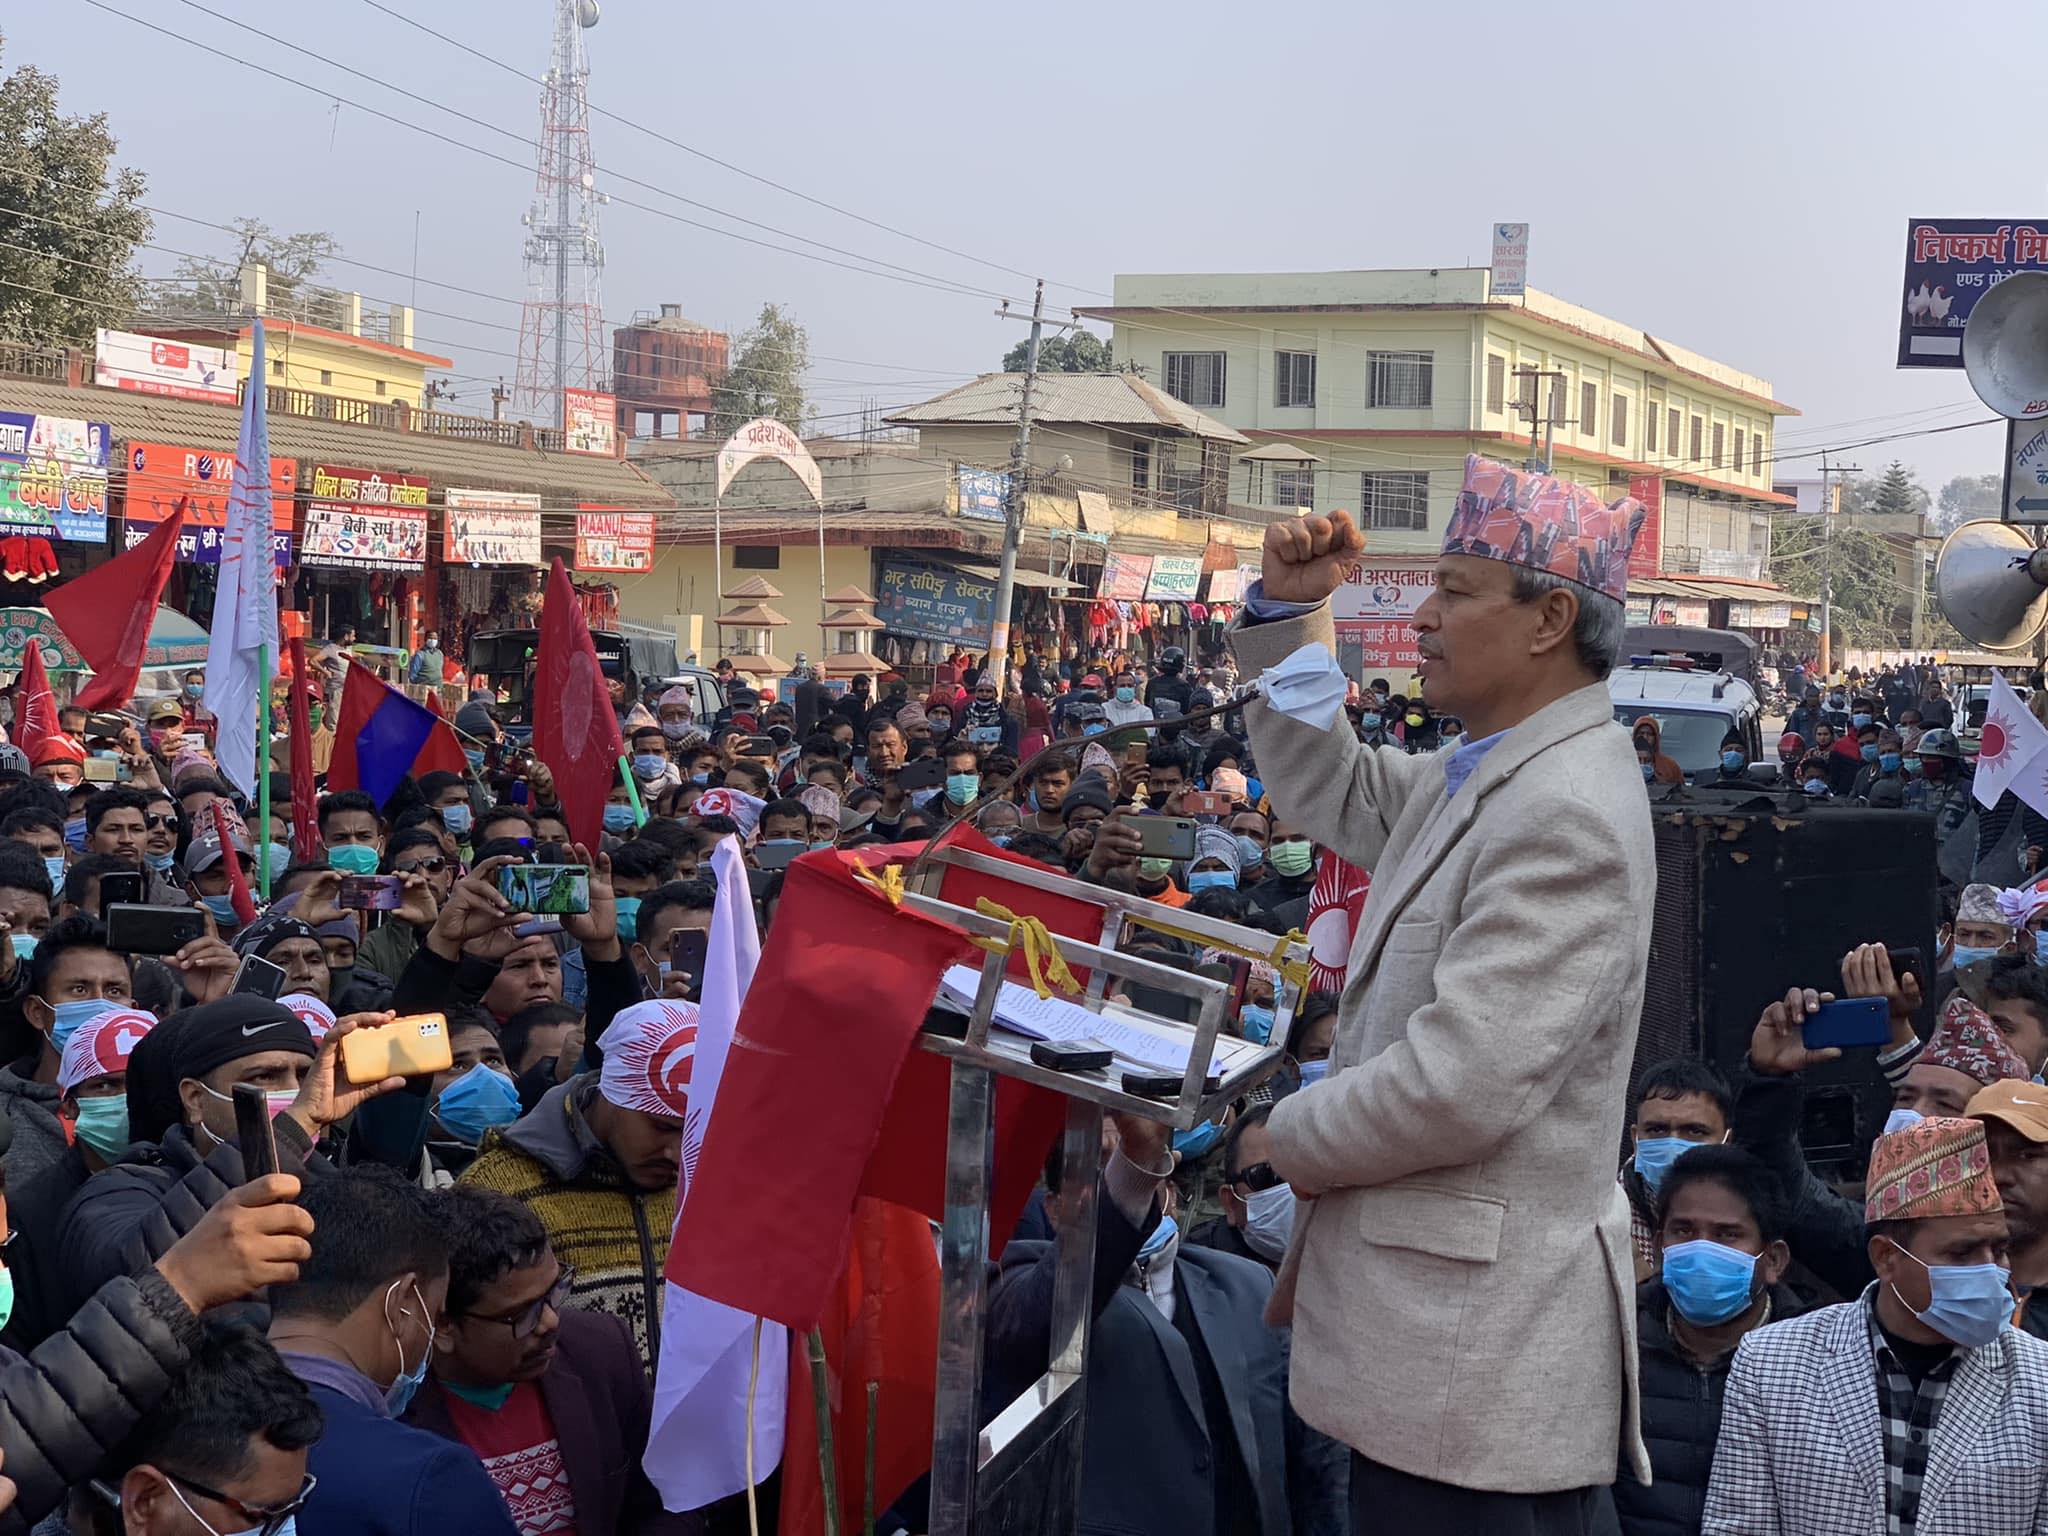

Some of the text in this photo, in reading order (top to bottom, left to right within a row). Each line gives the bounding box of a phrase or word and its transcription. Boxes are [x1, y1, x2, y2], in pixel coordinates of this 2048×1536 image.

[1913, 225, 2011, 264] निष्कर्ष
[1956, 273, 1984, 287] एण्ड
[748, 421, 798, 456] प्रदेश सभा
[184, 453, 235, 480] ROYA
[18, 458, 63, 510] बेबी
[342, 515, 367, 535] बेबी
[577, 513, 621, 537] MAANU
[955, 577, 997, 602] सेन्टर
[1365, 569, 1429, 587] अस्पताल
[937, 602, 968, 616] हाउस
[1387, 624, 1399, 643] सी
